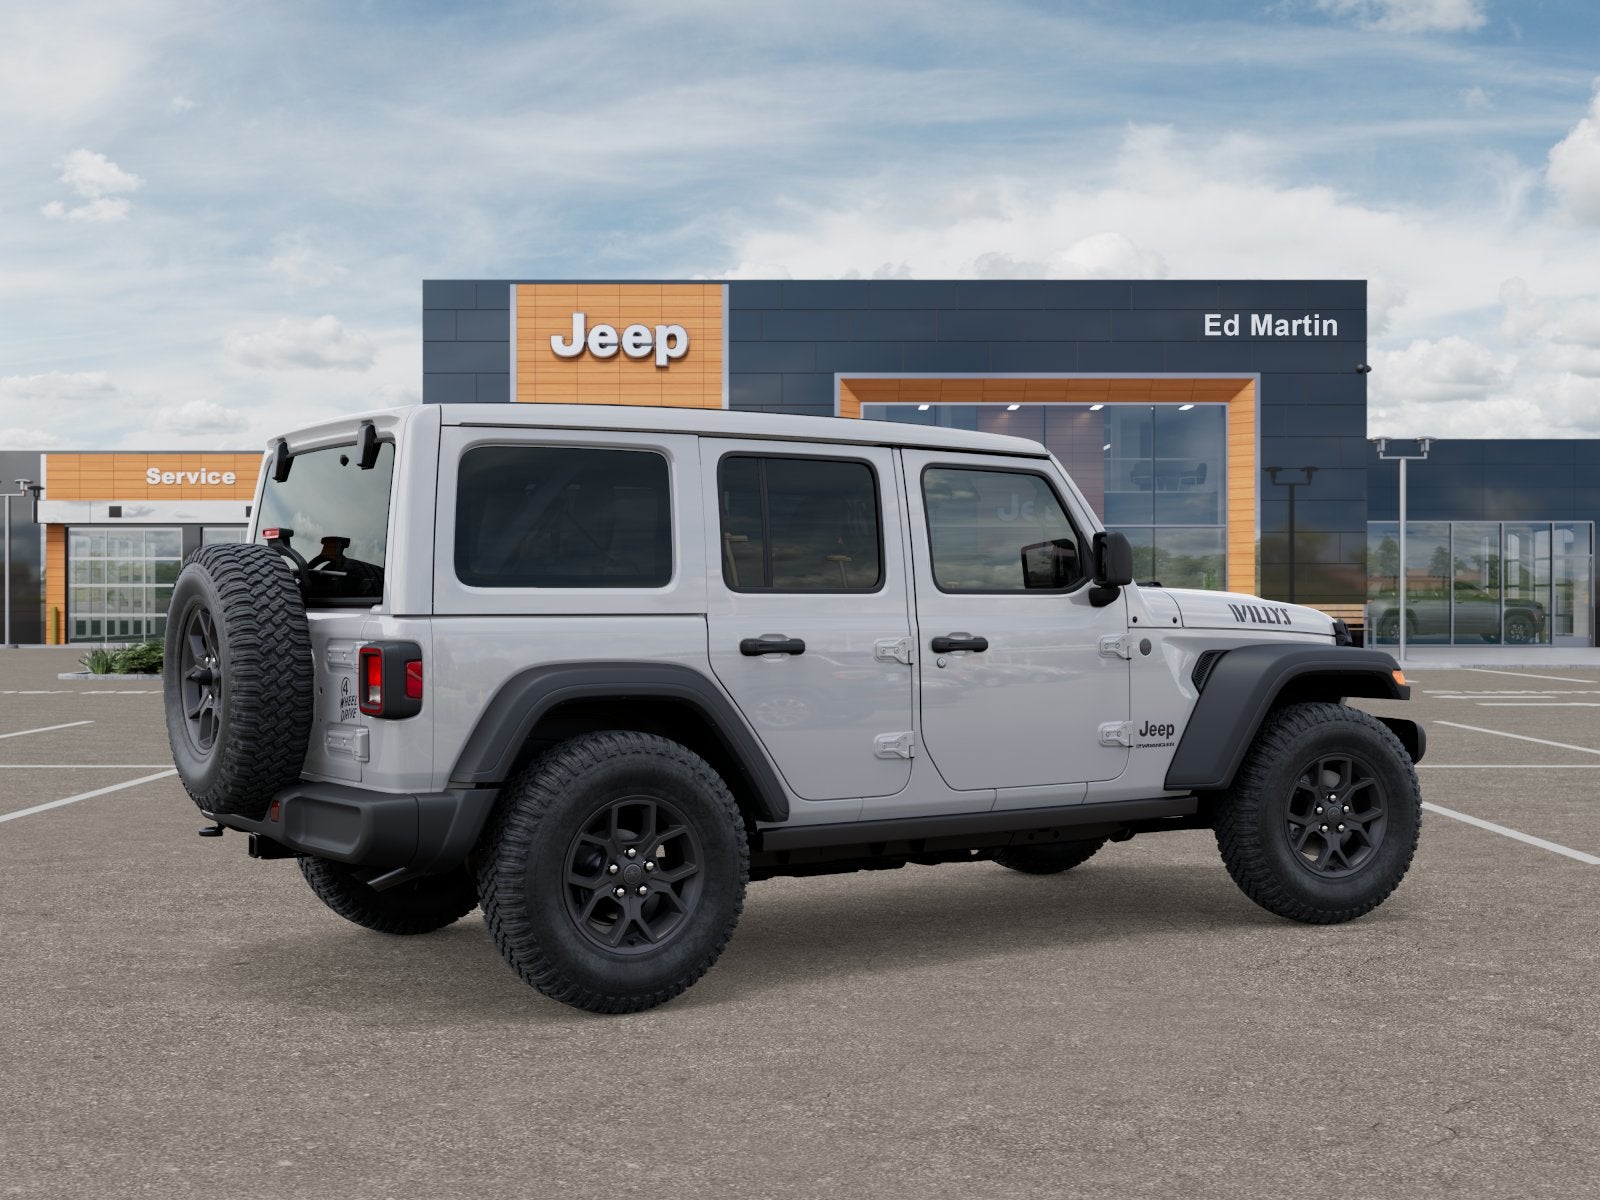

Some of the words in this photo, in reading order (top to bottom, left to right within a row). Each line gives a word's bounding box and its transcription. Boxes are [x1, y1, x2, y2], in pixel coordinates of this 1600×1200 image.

[1204, 313, 1240, 337] Ed
[1250, 313, 1338, 337] Martin
[550, 312, 690, 368] Jeep
[146, 467, 236, 485] Service
[1227, 603, 1292, 626] WILLYS
[340, 707, 357, 722] DRIVE
[1138, 720, 1175, 740] Jeep
